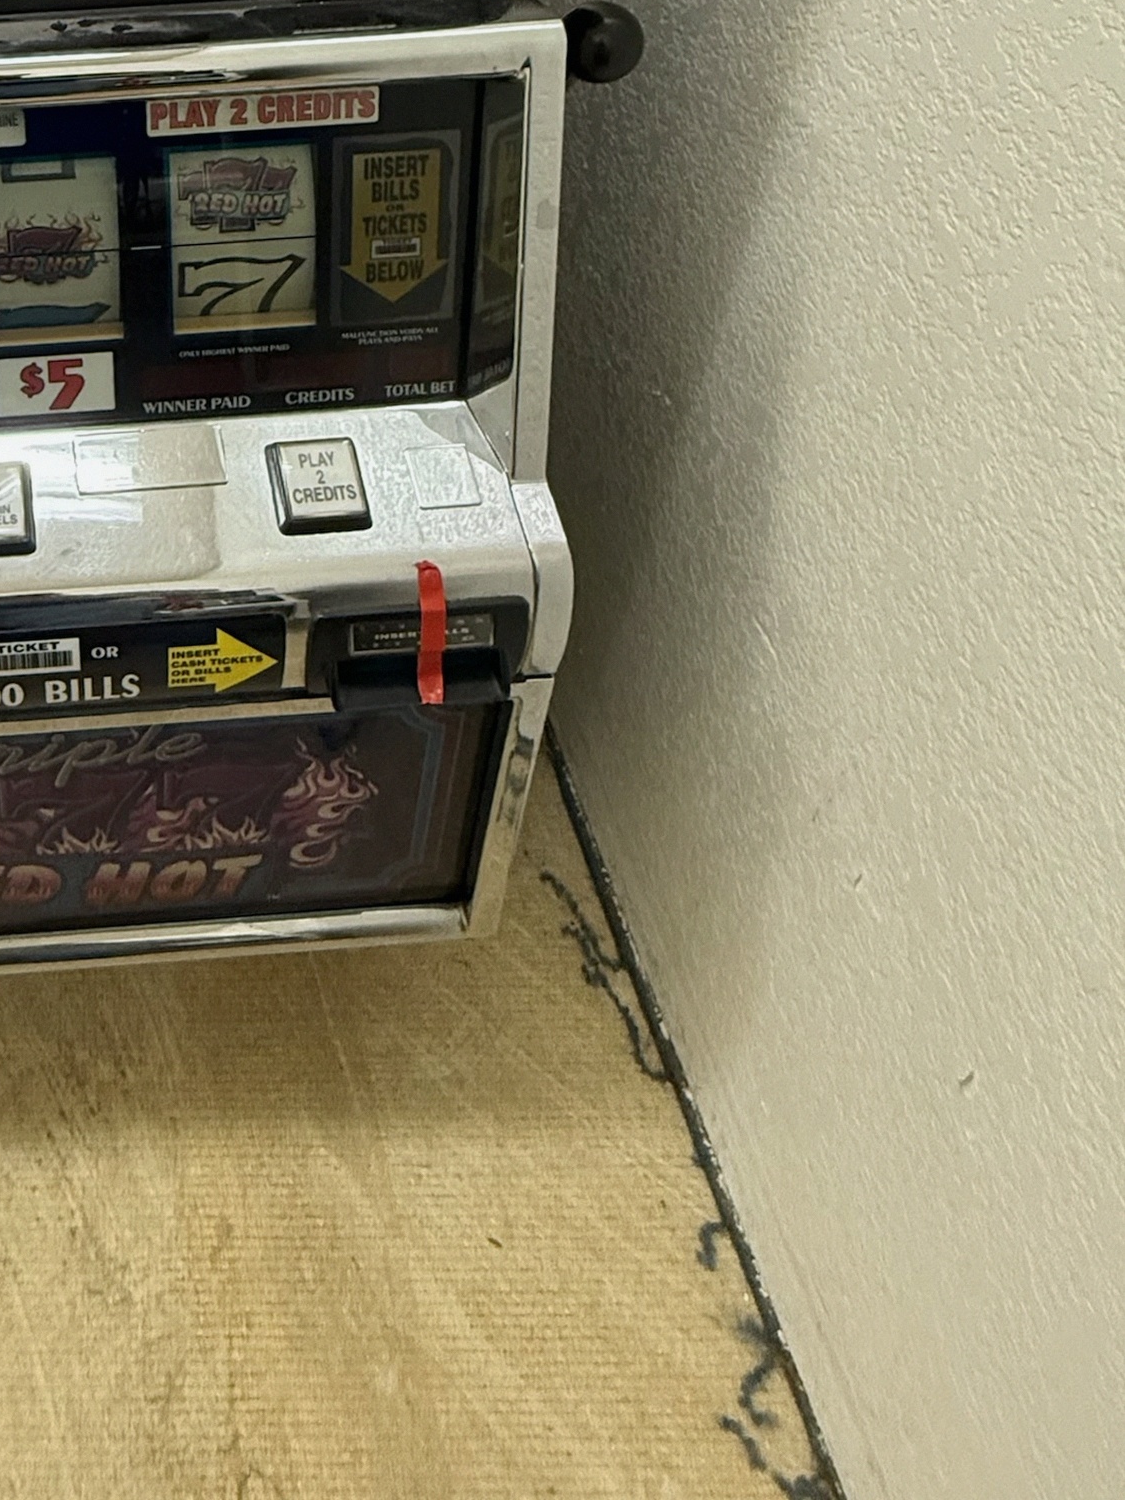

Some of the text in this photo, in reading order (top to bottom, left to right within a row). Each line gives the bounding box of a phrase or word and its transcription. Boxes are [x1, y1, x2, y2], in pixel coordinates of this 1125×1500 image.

[150, 89, 377, 130] PLAY 2 CREDITS
[363, 154, 429, 180] INSERT
[371, 179, 421, 203] BILLS
[386, 204, 405, 213] OR
[362, 214, 428, 238] TICKETS
[365, 260, 424, 284] BELOW
[19, 358, 86, 411] $5
[385, 380, 456, 398] TOTAL BET
[143, 394, 251, 415] WINNER PAID
[285, 387, 355, 405] CREDITS
[298, 452, 334, 469] PLAY
[316, 469, 326, 484] 2
[292, 484, 357, 504] CREDITS
[91, 645, 119, 660] OR
[171, 648, 221, 659] INSERT
[171, 653, 264, 668] CASH TICKETS
[171, 665, 232, 678] OR BILLS
[171, 675, 207, 685] HERE
[44, 674, 140, 704] BILLS
[86, 853, 263, 900] HOT
